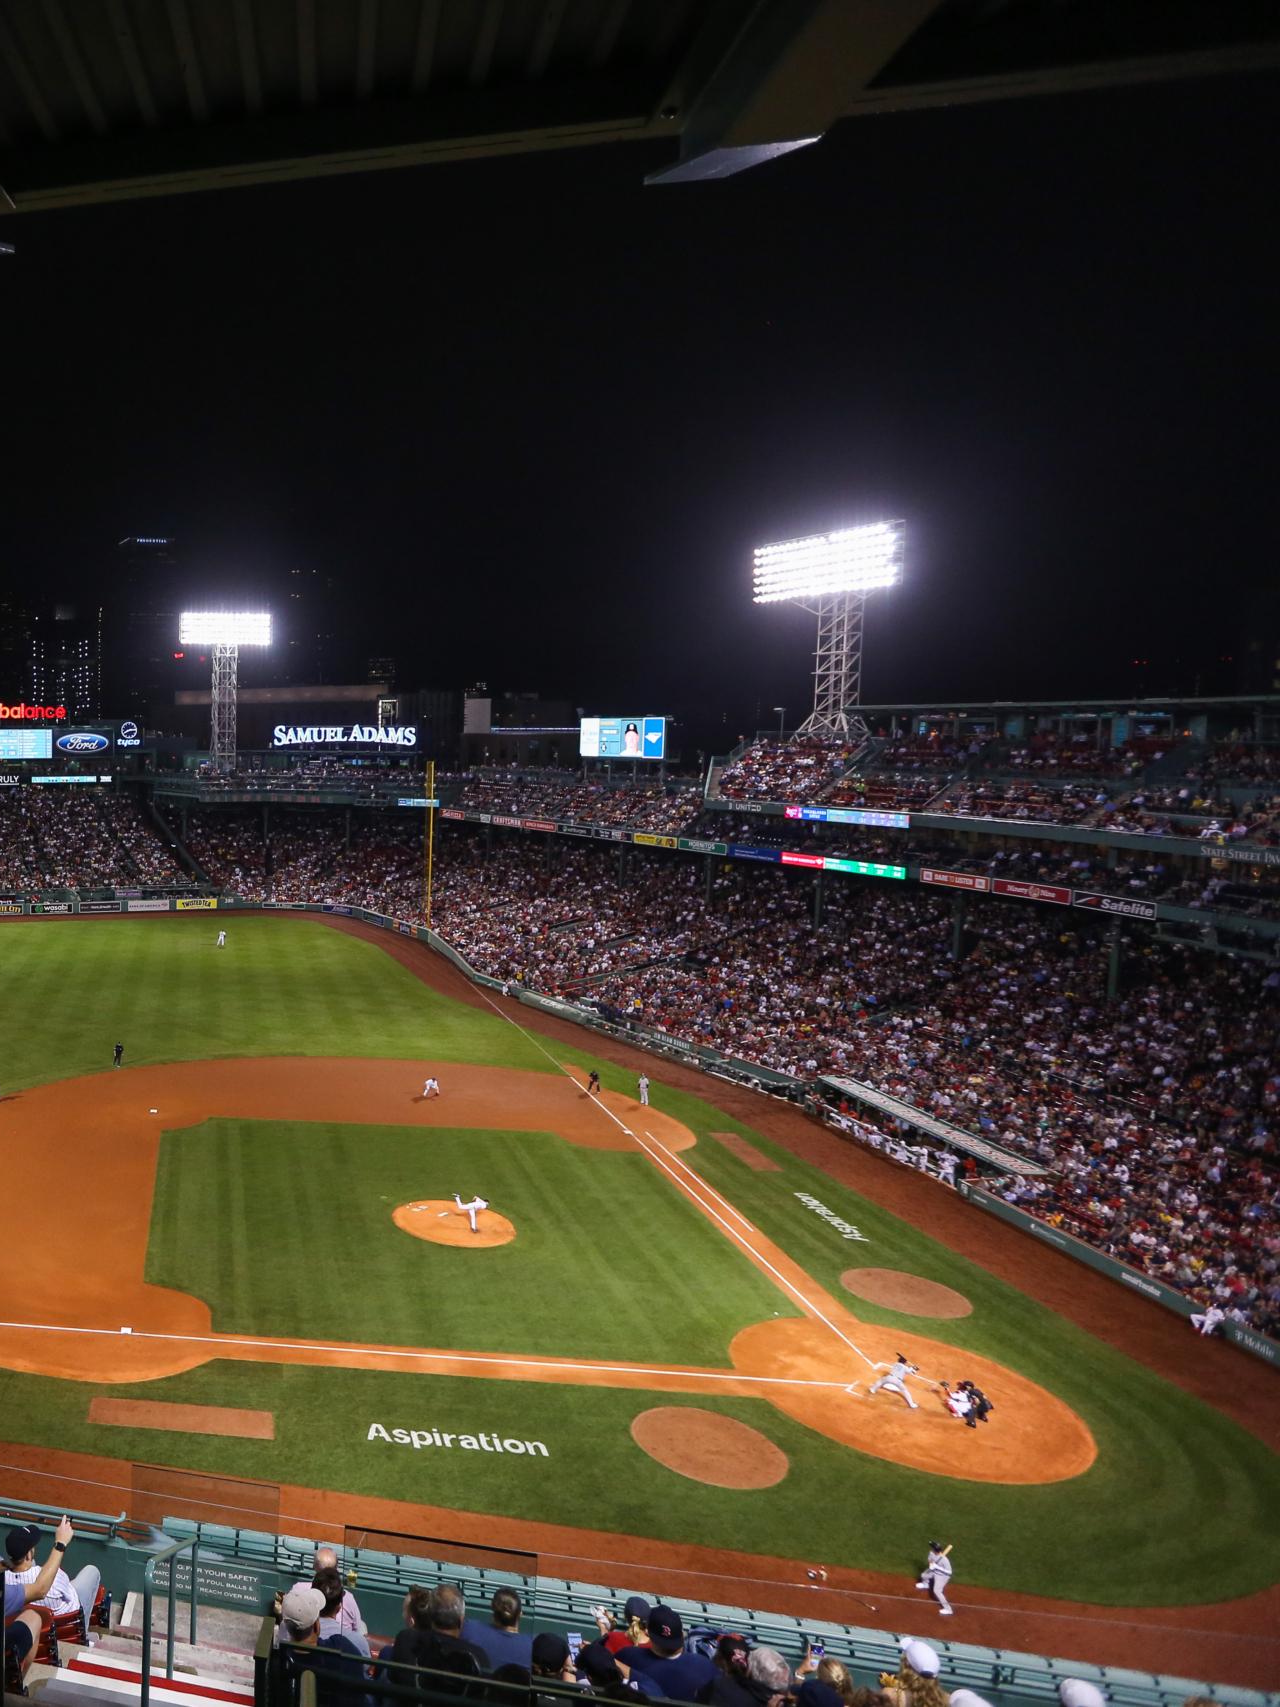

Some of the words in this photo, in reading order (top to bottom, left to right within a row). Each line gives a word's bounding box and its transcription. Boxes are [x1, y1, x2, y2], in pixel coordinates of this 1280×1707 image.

[0, 703, 66, 719] balance
[274, 725, 348, 746] SAMUEL
[349, 724, 416, 746] ADAMS
[67, 736, 98, 750] Ford
[117, 738, 140, 747] tyco
[493, 816, 520, 826] CRAFTSMAN
[688, 841, 715, 850] HORNITOS
[1200, 847, 1227, 858] STATE
[1228, 848, 1261, 862] STREET
[44, 904, 68, 912] wasabi
[182, 900, 202, 908] TWISTED
[202, 900, 211, 908] TEA
[1100, 899, 1154, 917] Safelite
[793, 1192, 870, 1242] Aspiration
[1244, 1334, 1275, 1358] Mobile
[367, 1423, 550, 1456] Aspiration
[204, 1569, 226, 1577] YOUR
[228, 1573, 258, 1582] SAFETY
[206, 1578, 224, 1587] FOUL
[200, 1587, 222, 1595] REACH
[244, 1594, 258, 1602] RAIL
